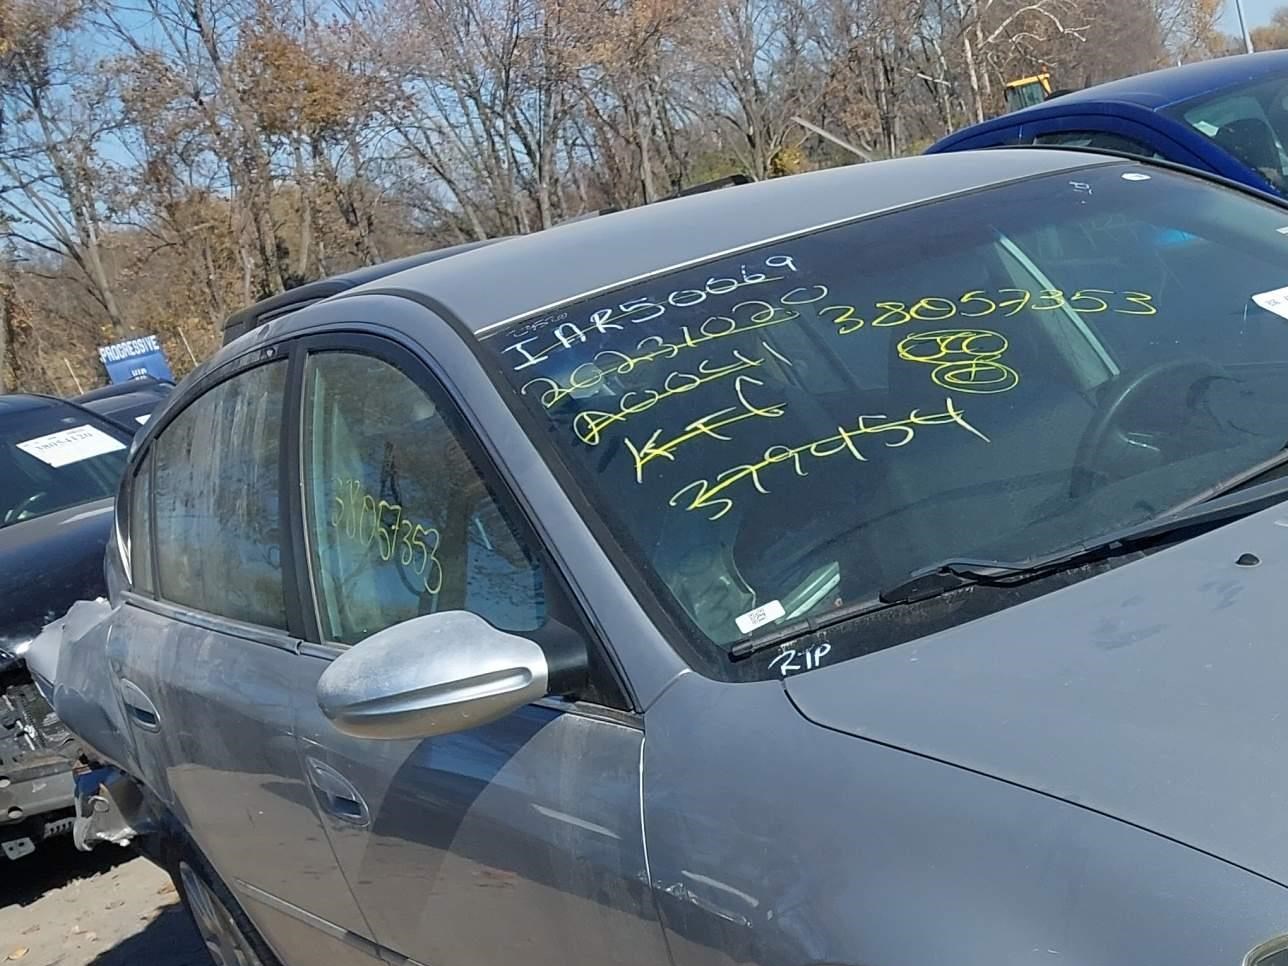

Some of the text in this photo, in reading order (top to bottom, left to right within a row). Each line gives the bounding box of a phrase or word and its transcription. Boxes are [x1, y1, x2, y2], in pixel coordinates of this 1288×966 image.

[502, 256, 797, 370] IAR50069
[818, 288, 1157, 335] 38057353
[99, 335, 160, 363] PROGRESSIVE
[521, 285, 828, 408] 20231020
[767, 643, 832, 676] RIP
